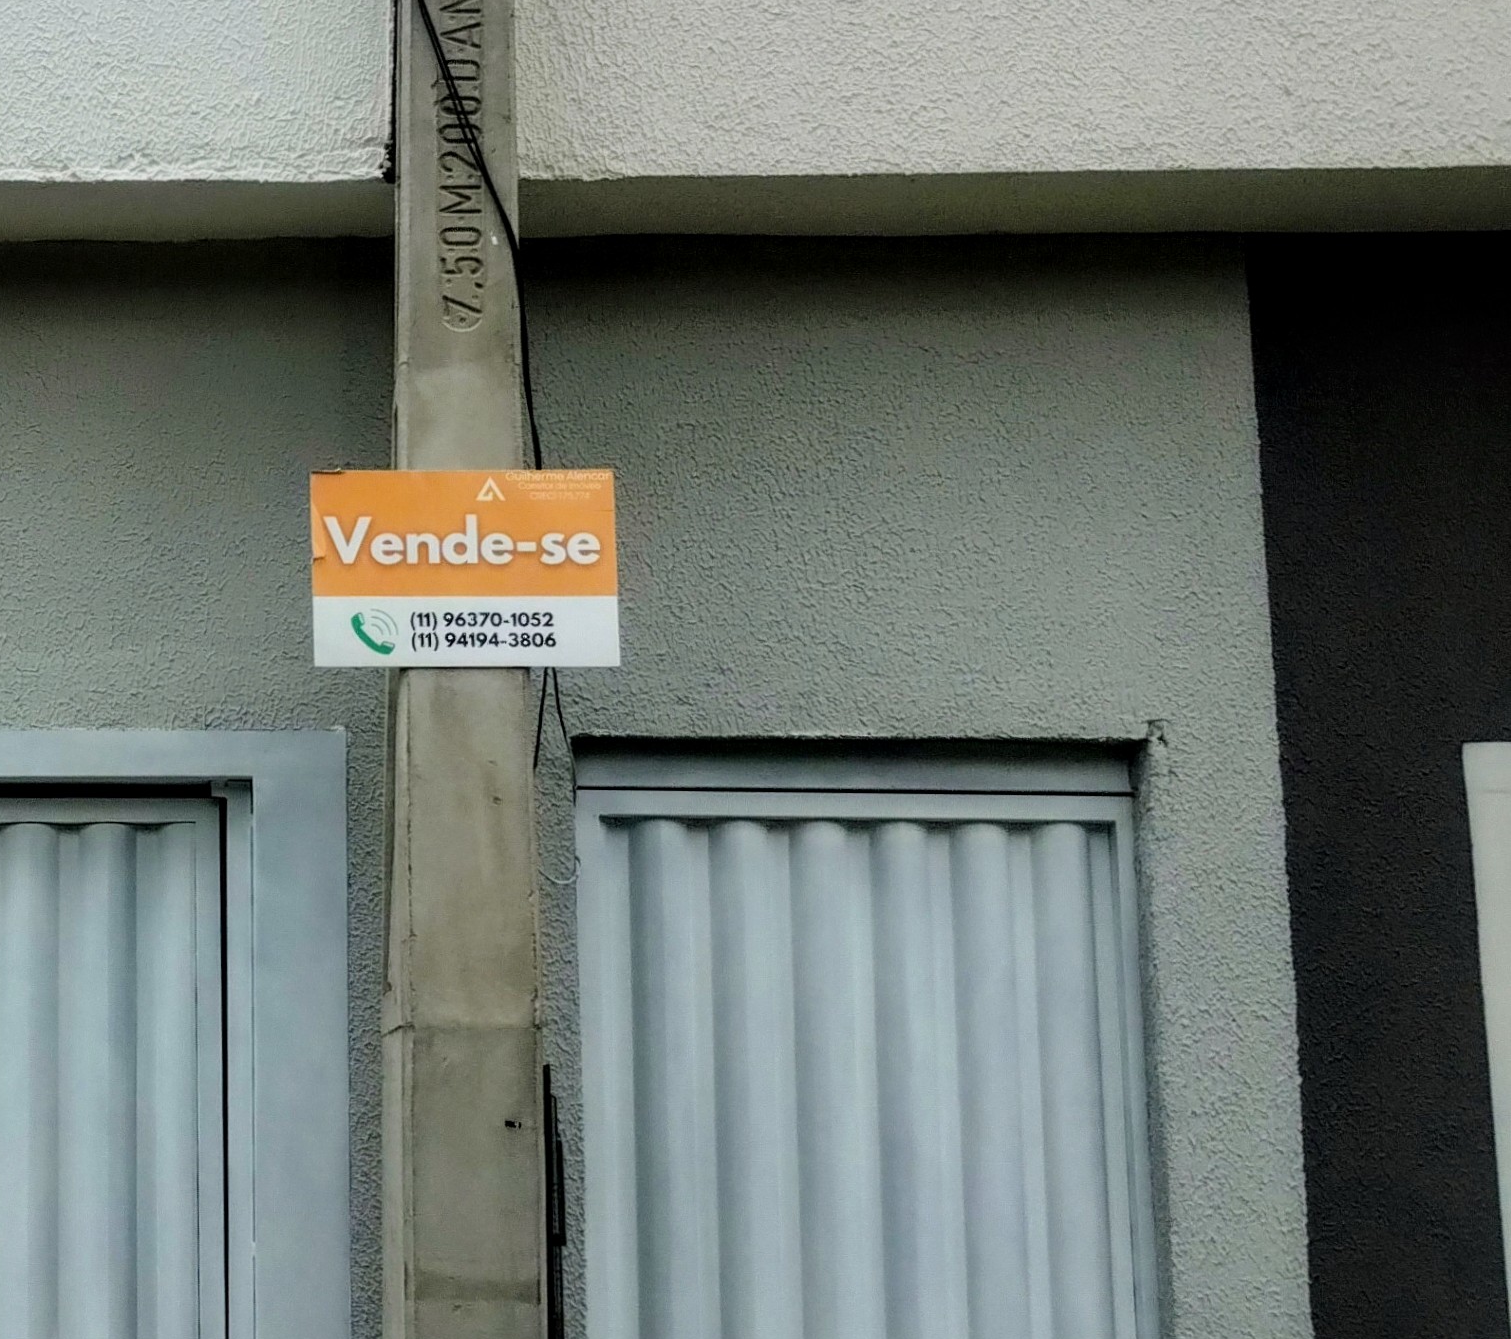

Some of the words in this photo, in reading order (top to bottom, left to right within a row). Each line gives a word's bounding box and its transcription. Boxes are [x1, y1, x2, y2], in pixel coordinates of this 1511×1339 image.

[323, 513, 601, 566] Vende-se
[410, 611, 437, 631] (11)
[443, 612, 554, 627] 96370-1052
[411, 632, 439, 652] (11)
[444, 632, 557, 648] 94194-3806
